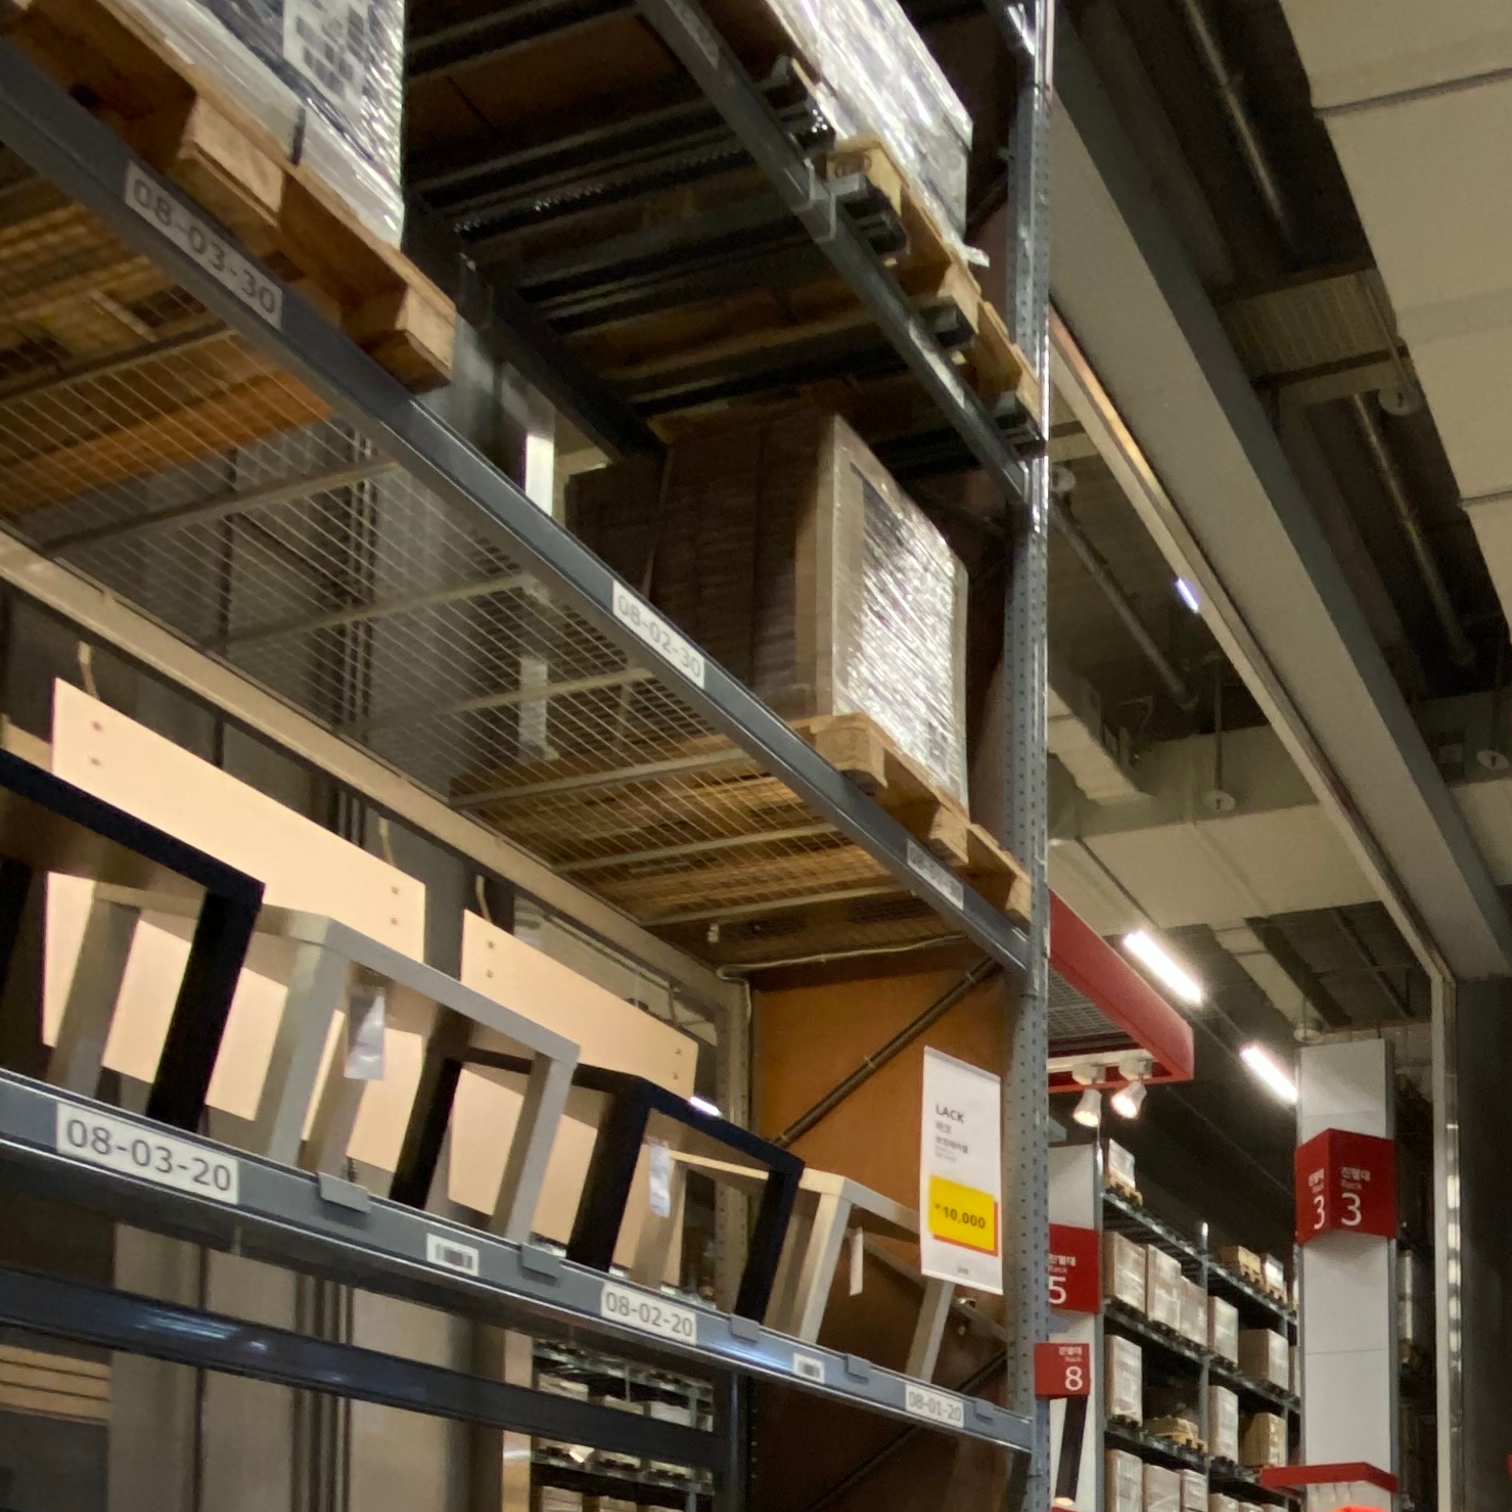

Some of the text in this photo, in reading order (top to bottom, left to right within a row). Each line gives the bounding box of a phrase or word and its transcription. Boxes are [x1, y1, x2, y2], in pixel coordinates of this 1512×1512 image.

[134, 178, 276, 314] 08-03-30
[618, 594, 700, 678] 08-02-30
[935, 1103, 964, 1124] LACK
[67, 1119, 231, 1192] 08-03-20
[1313, 1194, 1326, 1230] 3
[1341, 1191, 1362, 1227] 3
[1047, 1276, 1067, 1305] 5
[606, 1291, 693, 1337] 08-02-20
[1064, 1366, 1083, 1391] 8
